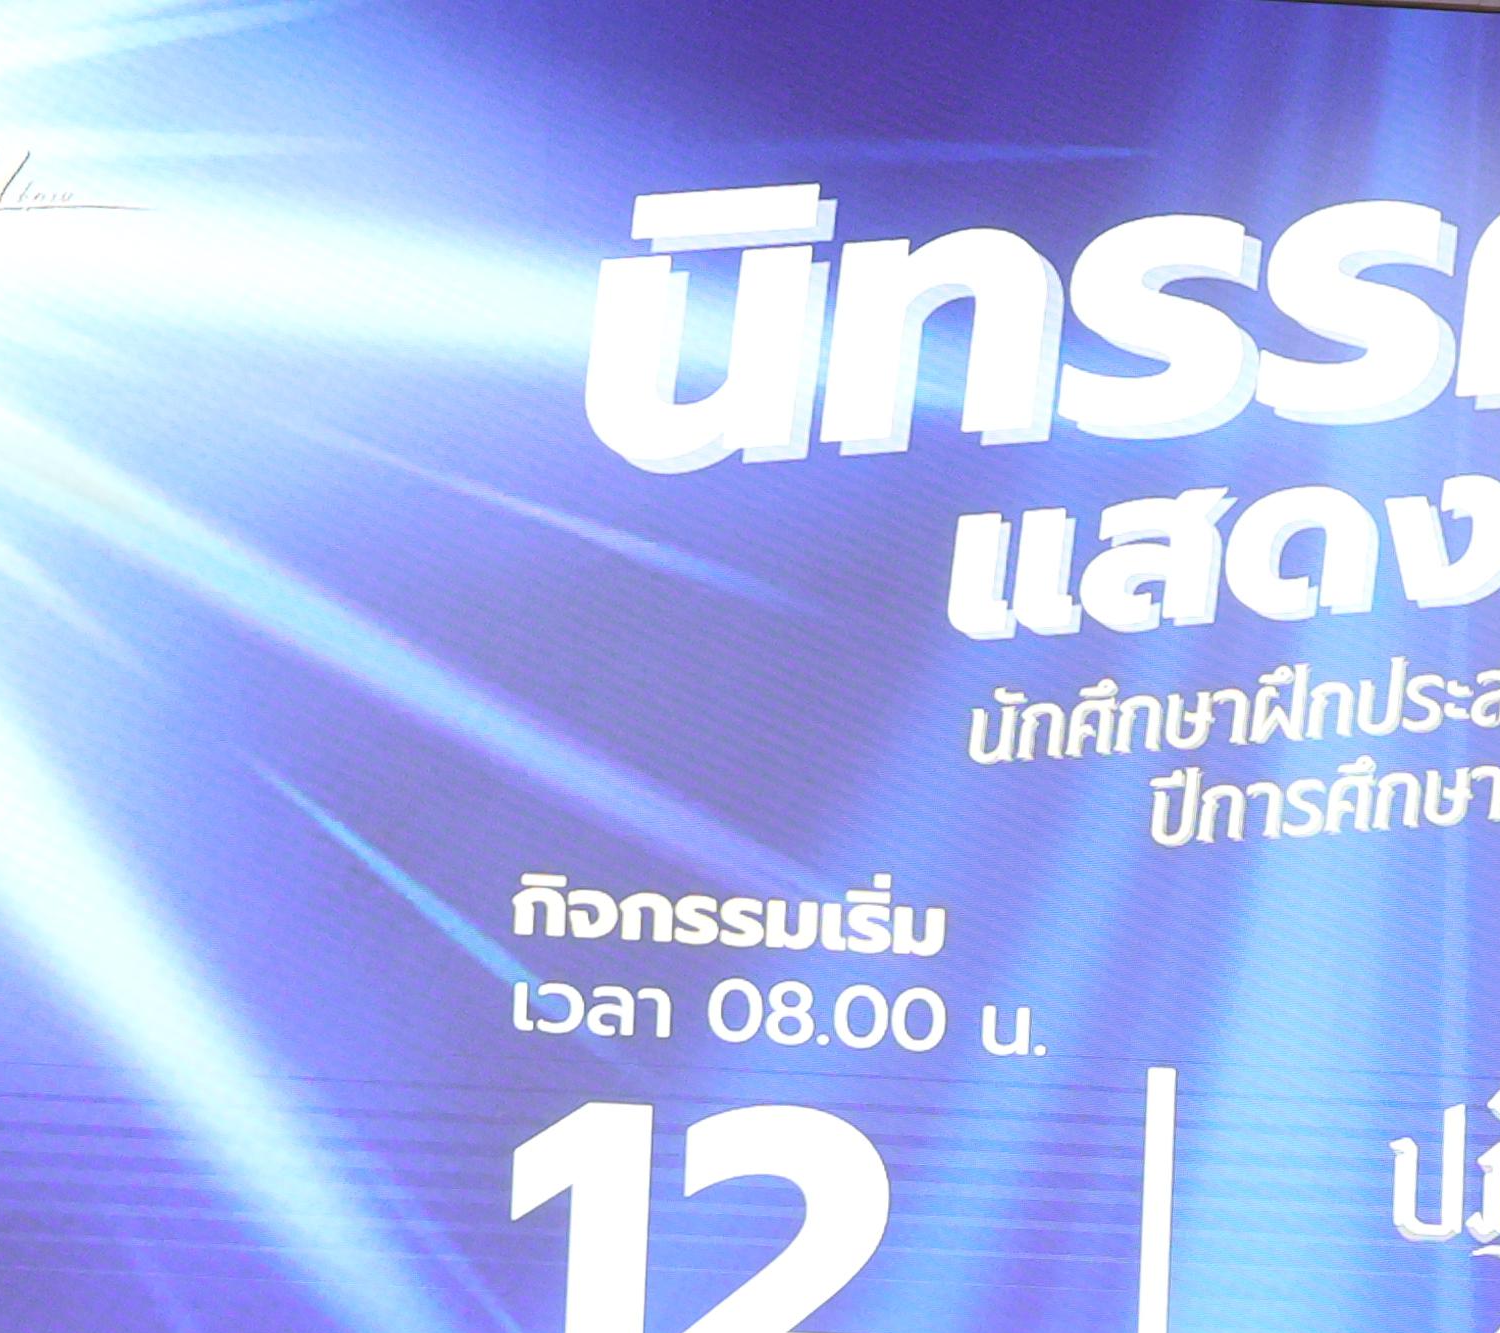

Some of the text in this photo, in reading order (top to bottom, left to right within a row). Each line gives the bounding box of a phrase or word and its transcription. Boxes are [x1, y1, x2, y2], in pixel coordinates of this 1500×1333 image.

[511, 873, 947, 958] กิจกรรมเริ่ม
[512, 977, 1048, 1057] เวลา 08.00 น.
